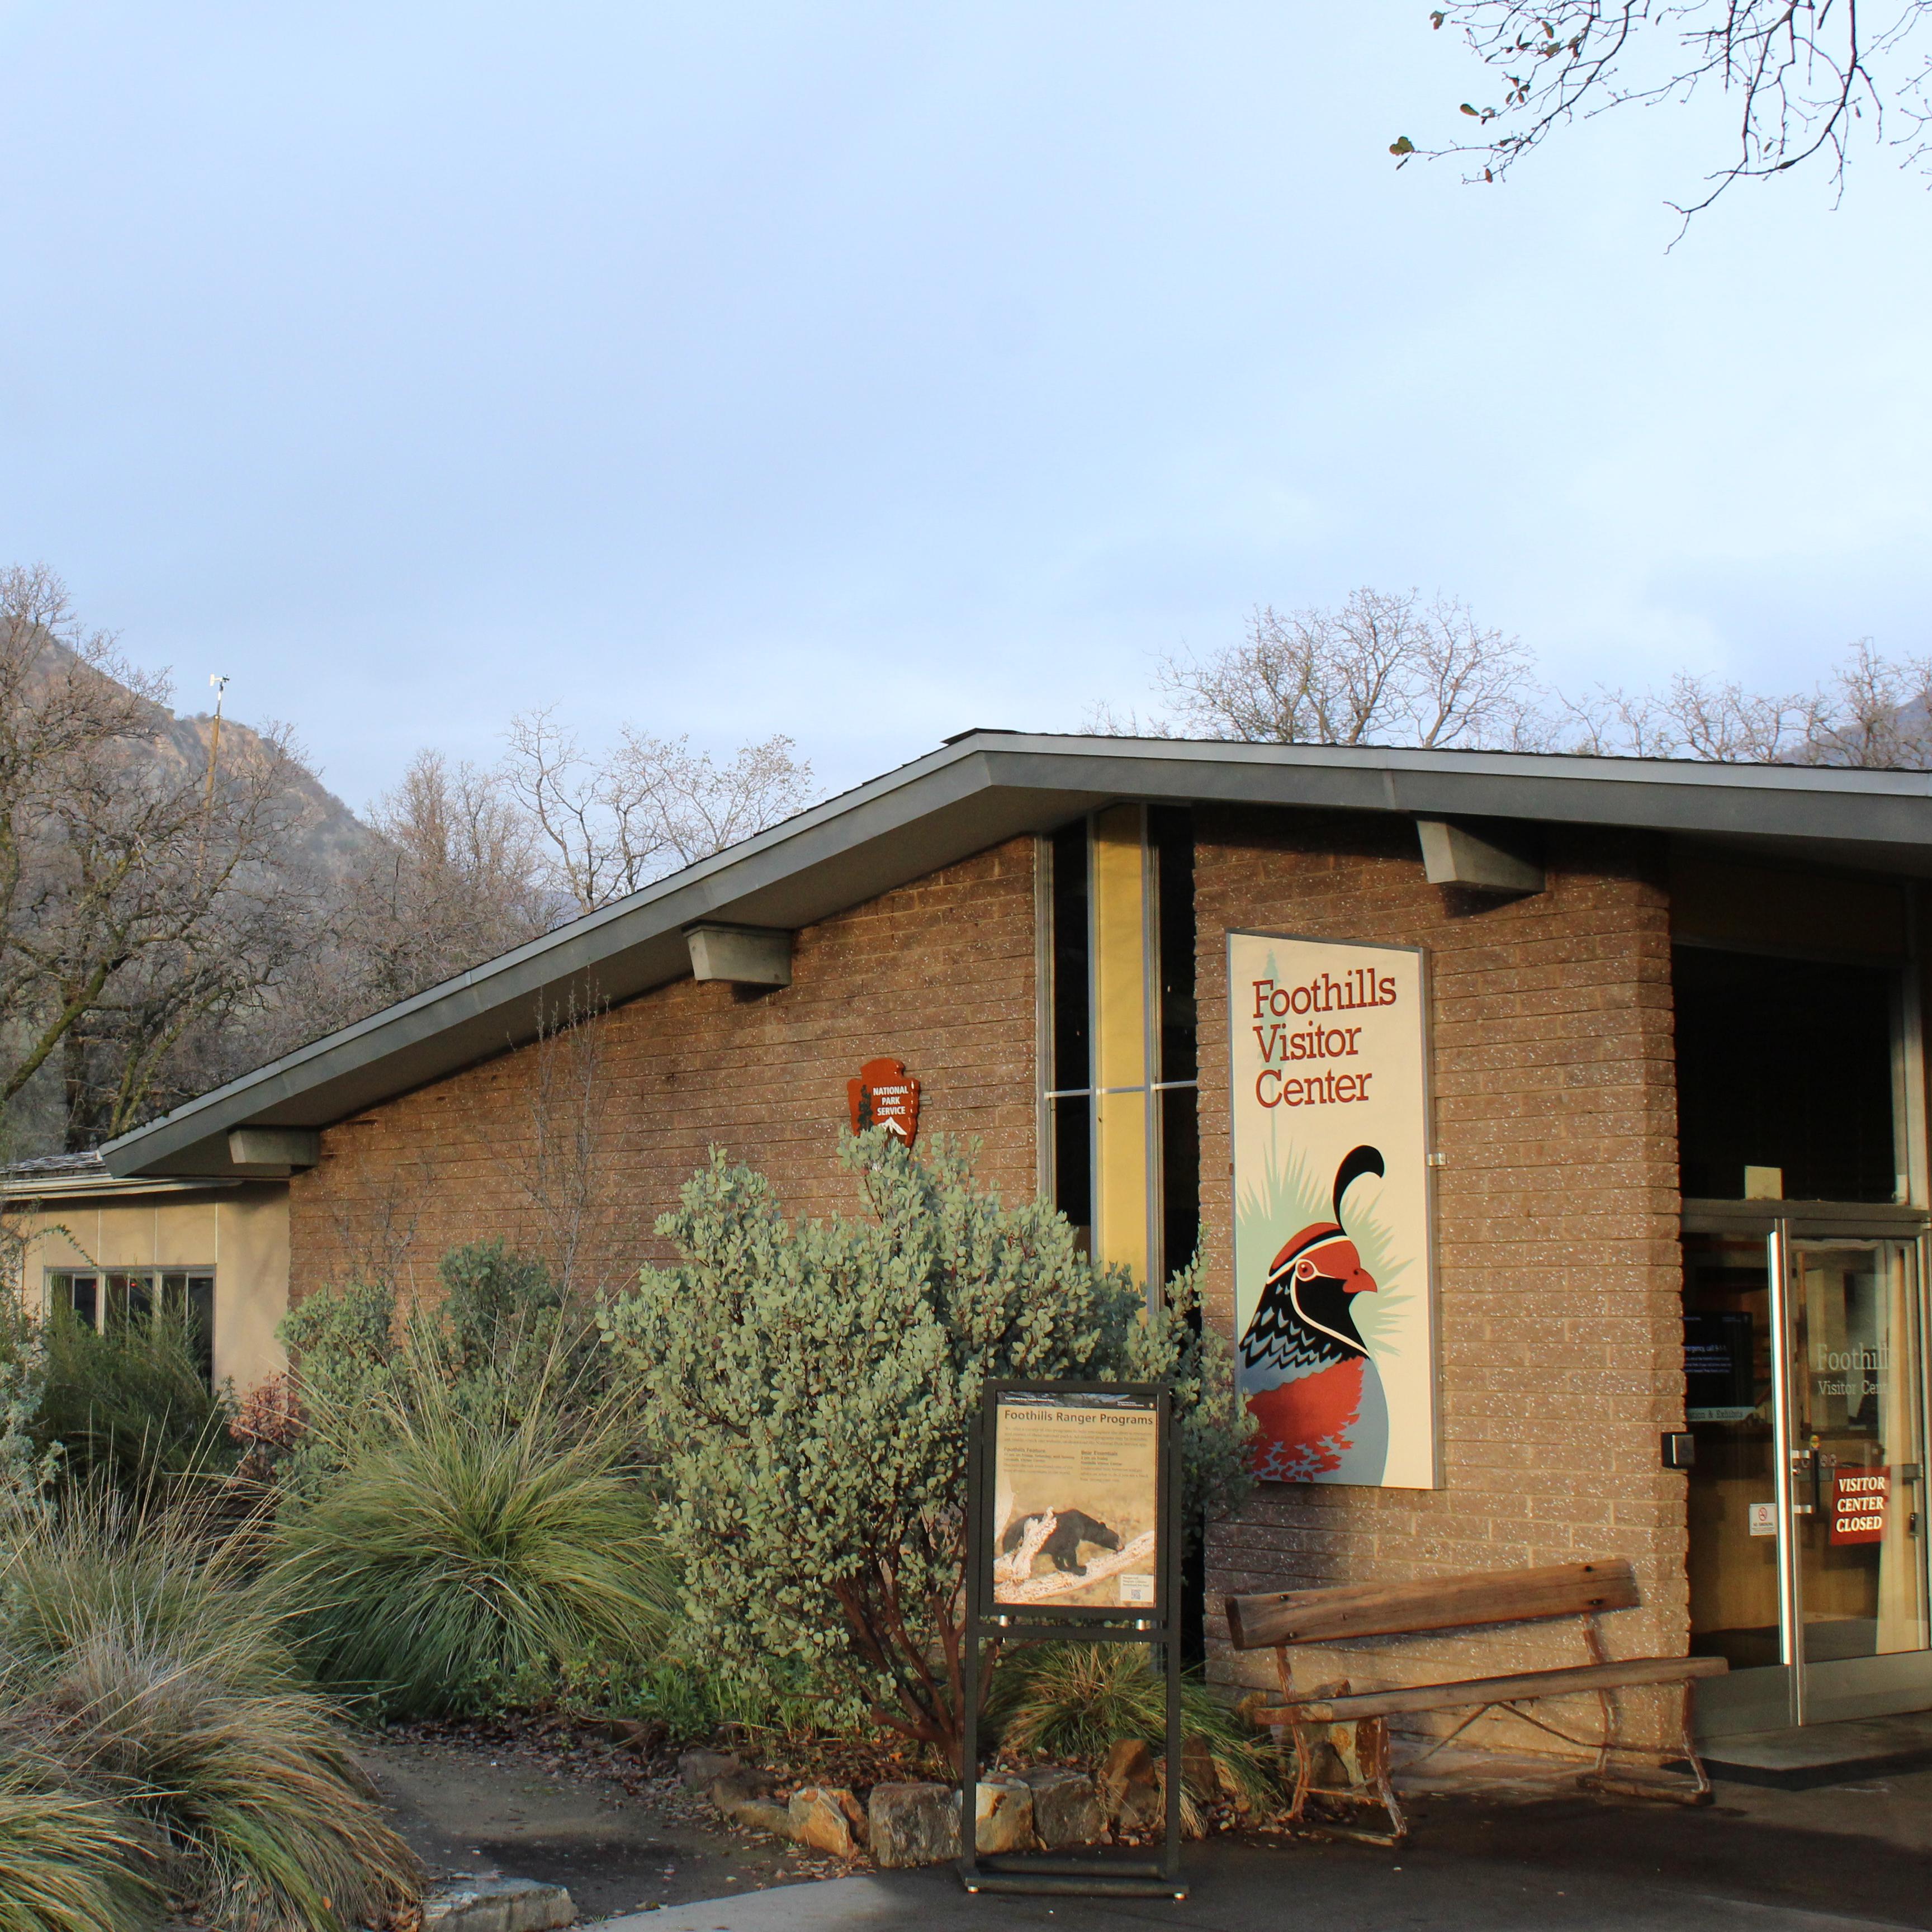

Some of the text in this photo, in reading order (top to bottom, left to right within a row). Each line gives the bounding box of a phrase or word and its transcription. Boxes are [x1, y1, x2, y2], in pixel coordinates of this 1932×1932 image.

[1252, 968, 1396, 1019] Foothills
[1252, 1021, 1362, 1063] Visitor
[873, 1086, 909, 1096] NATIONAL
[1255, 1068, 1372, 1109] Center
[882, 1096, 900, 1105] PARK
[877, 1106, 906, 1116] SERVICE
[1818, 1380, 1857, 1395] Visitor
[1005, 1410, 1153, 1426] Foothills Ranger Programs
[1838, 1476, 1886, 1493] VISITOR
[1837, 1496, 1884, 1513] CENTER
[1836, 1516, 1882, 1533] CLOSED
